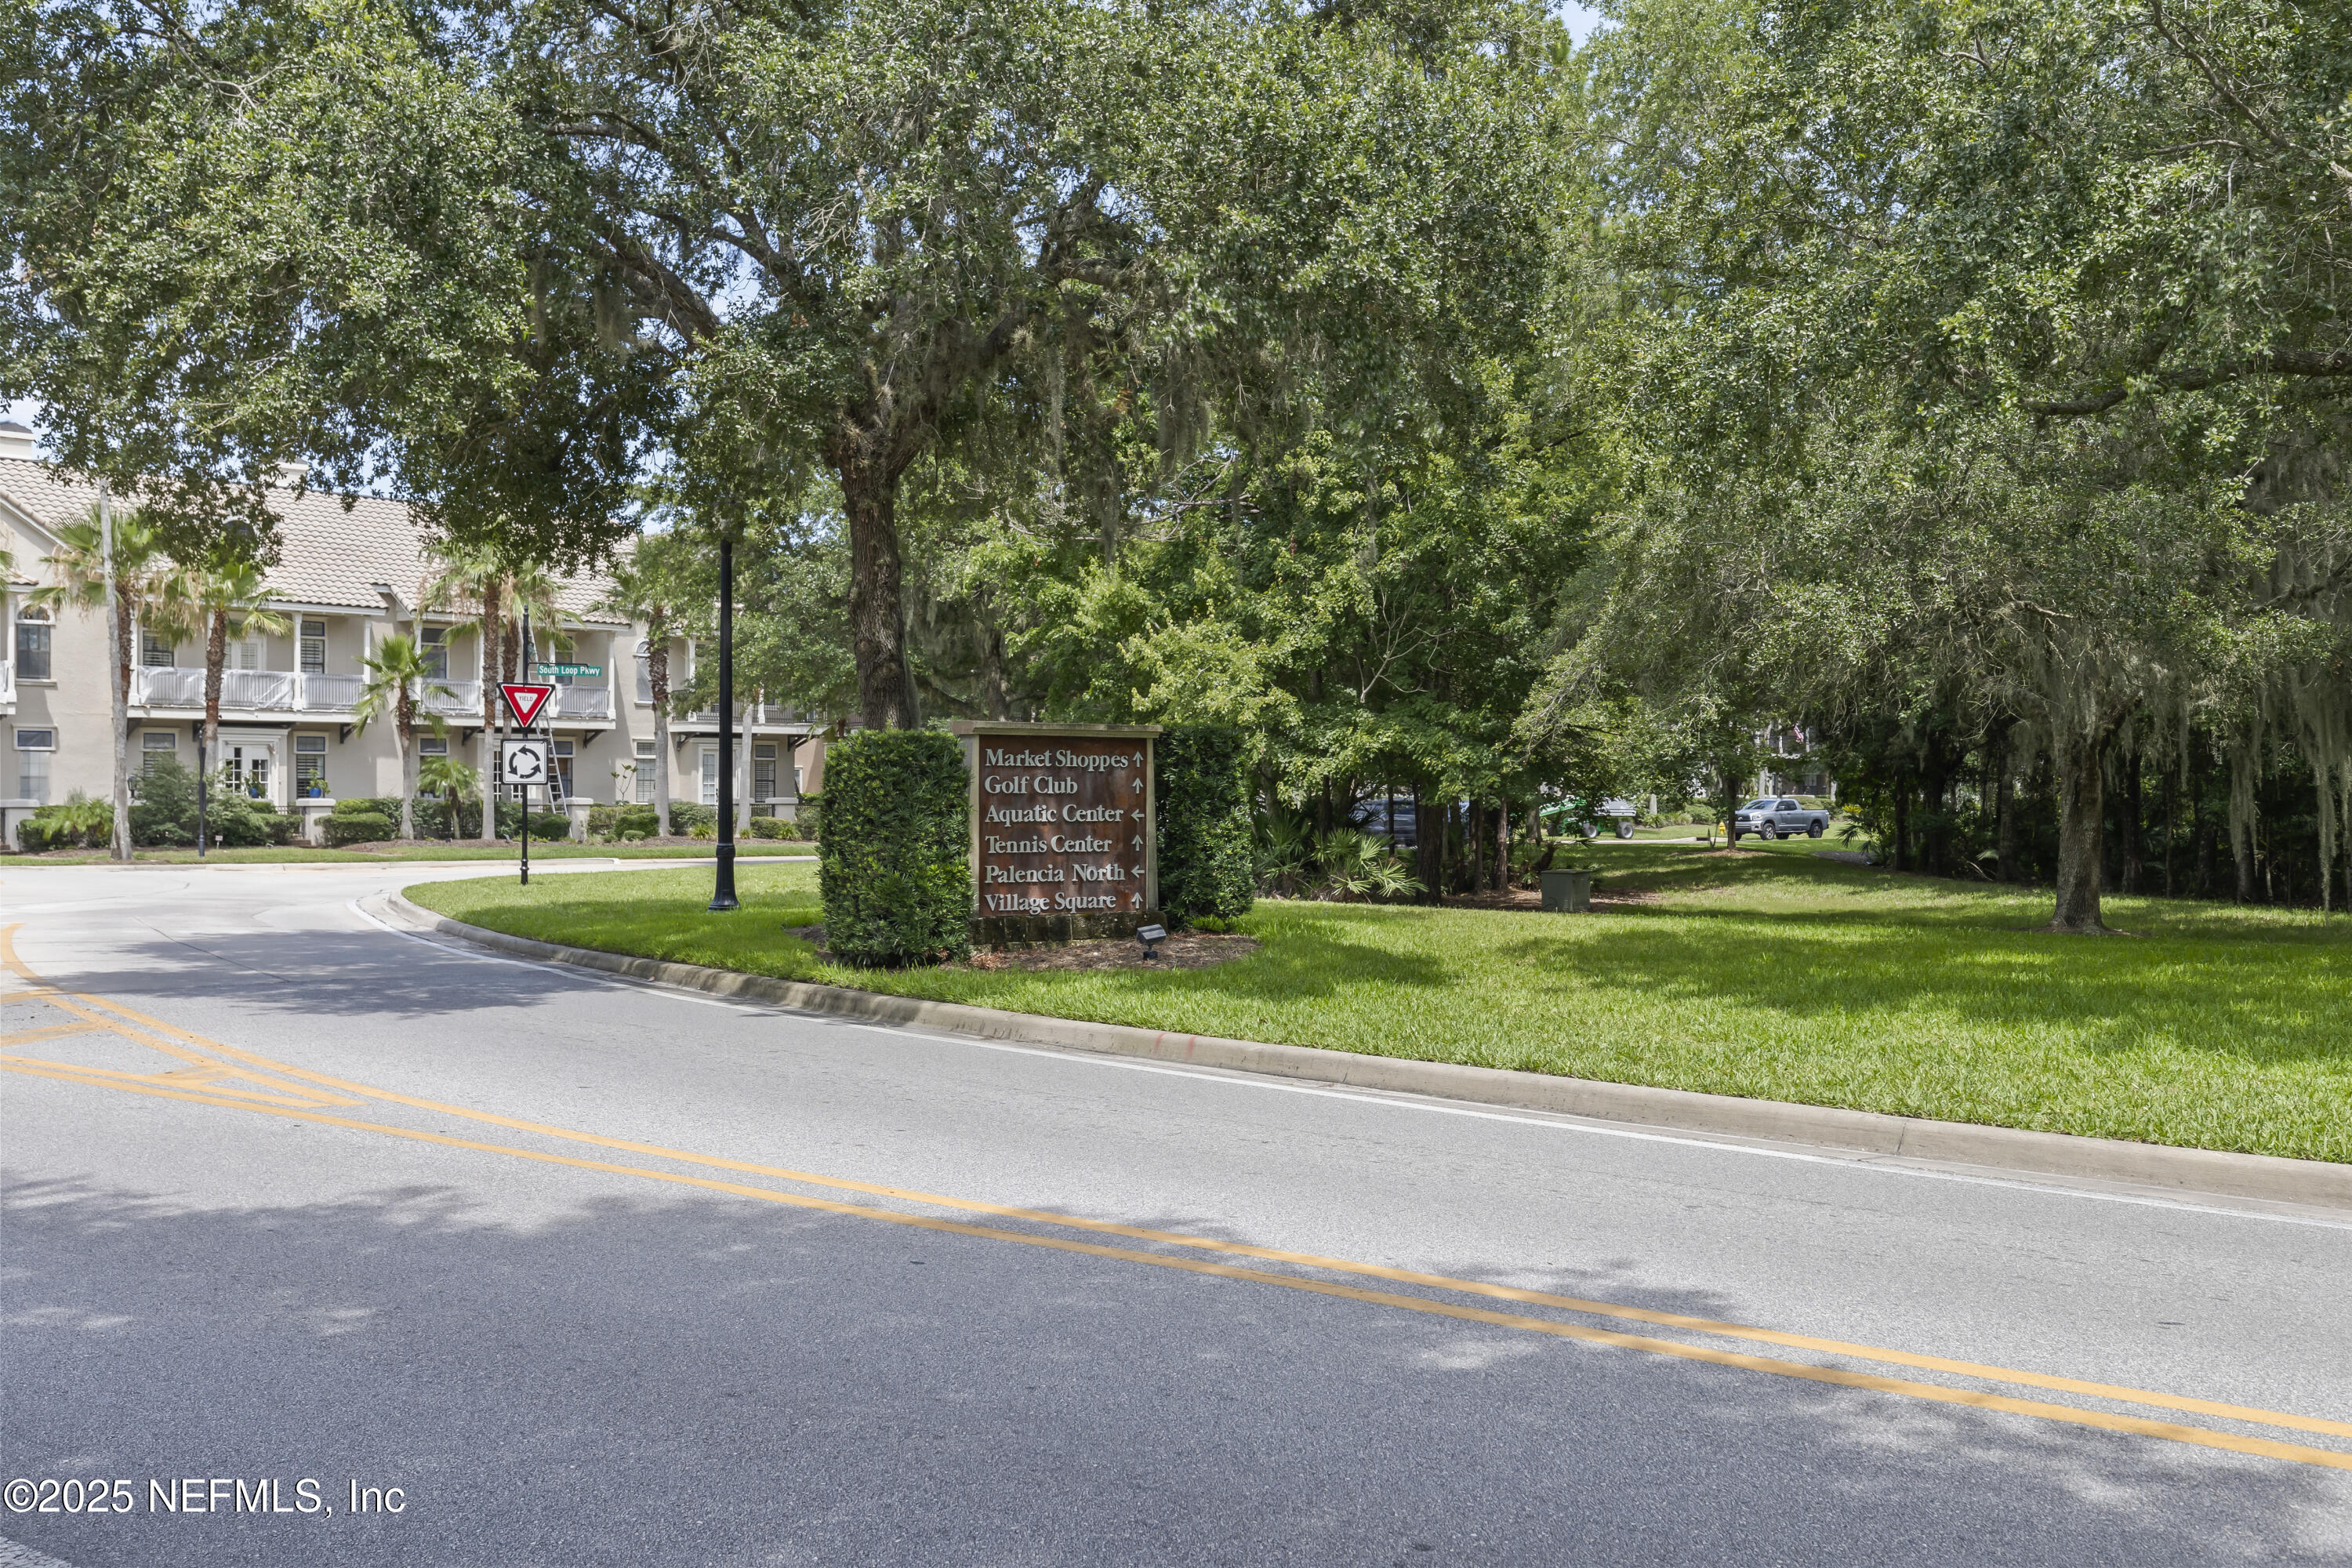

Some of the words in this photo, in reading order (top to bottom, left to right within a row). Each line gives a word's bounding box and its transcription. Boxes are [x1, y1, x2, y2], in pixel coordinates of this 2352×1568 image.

[561, 666, 578, 675] Loop
[580, 666, 600, 676] Pkwy
[985, 749, 1051, 767] Market
[1056, 750, 1129, 771] Shoppes
[985, 775, 1029, 793] Golf
[1033, 777, 1078, 793] Club
[985, 804, 1057, 826] Aquatic
[1062, 804, 1123, 822] Center
[985, 835, 1047, 853] Tennis
[1051, 835, 1112, 852] Center
[985, 865, 1065, 884] Palencia
[1072, 863, 1126, 882] North
[985, 893, 1050, 914] Village
[1054, 892, 1116, 913] Square
